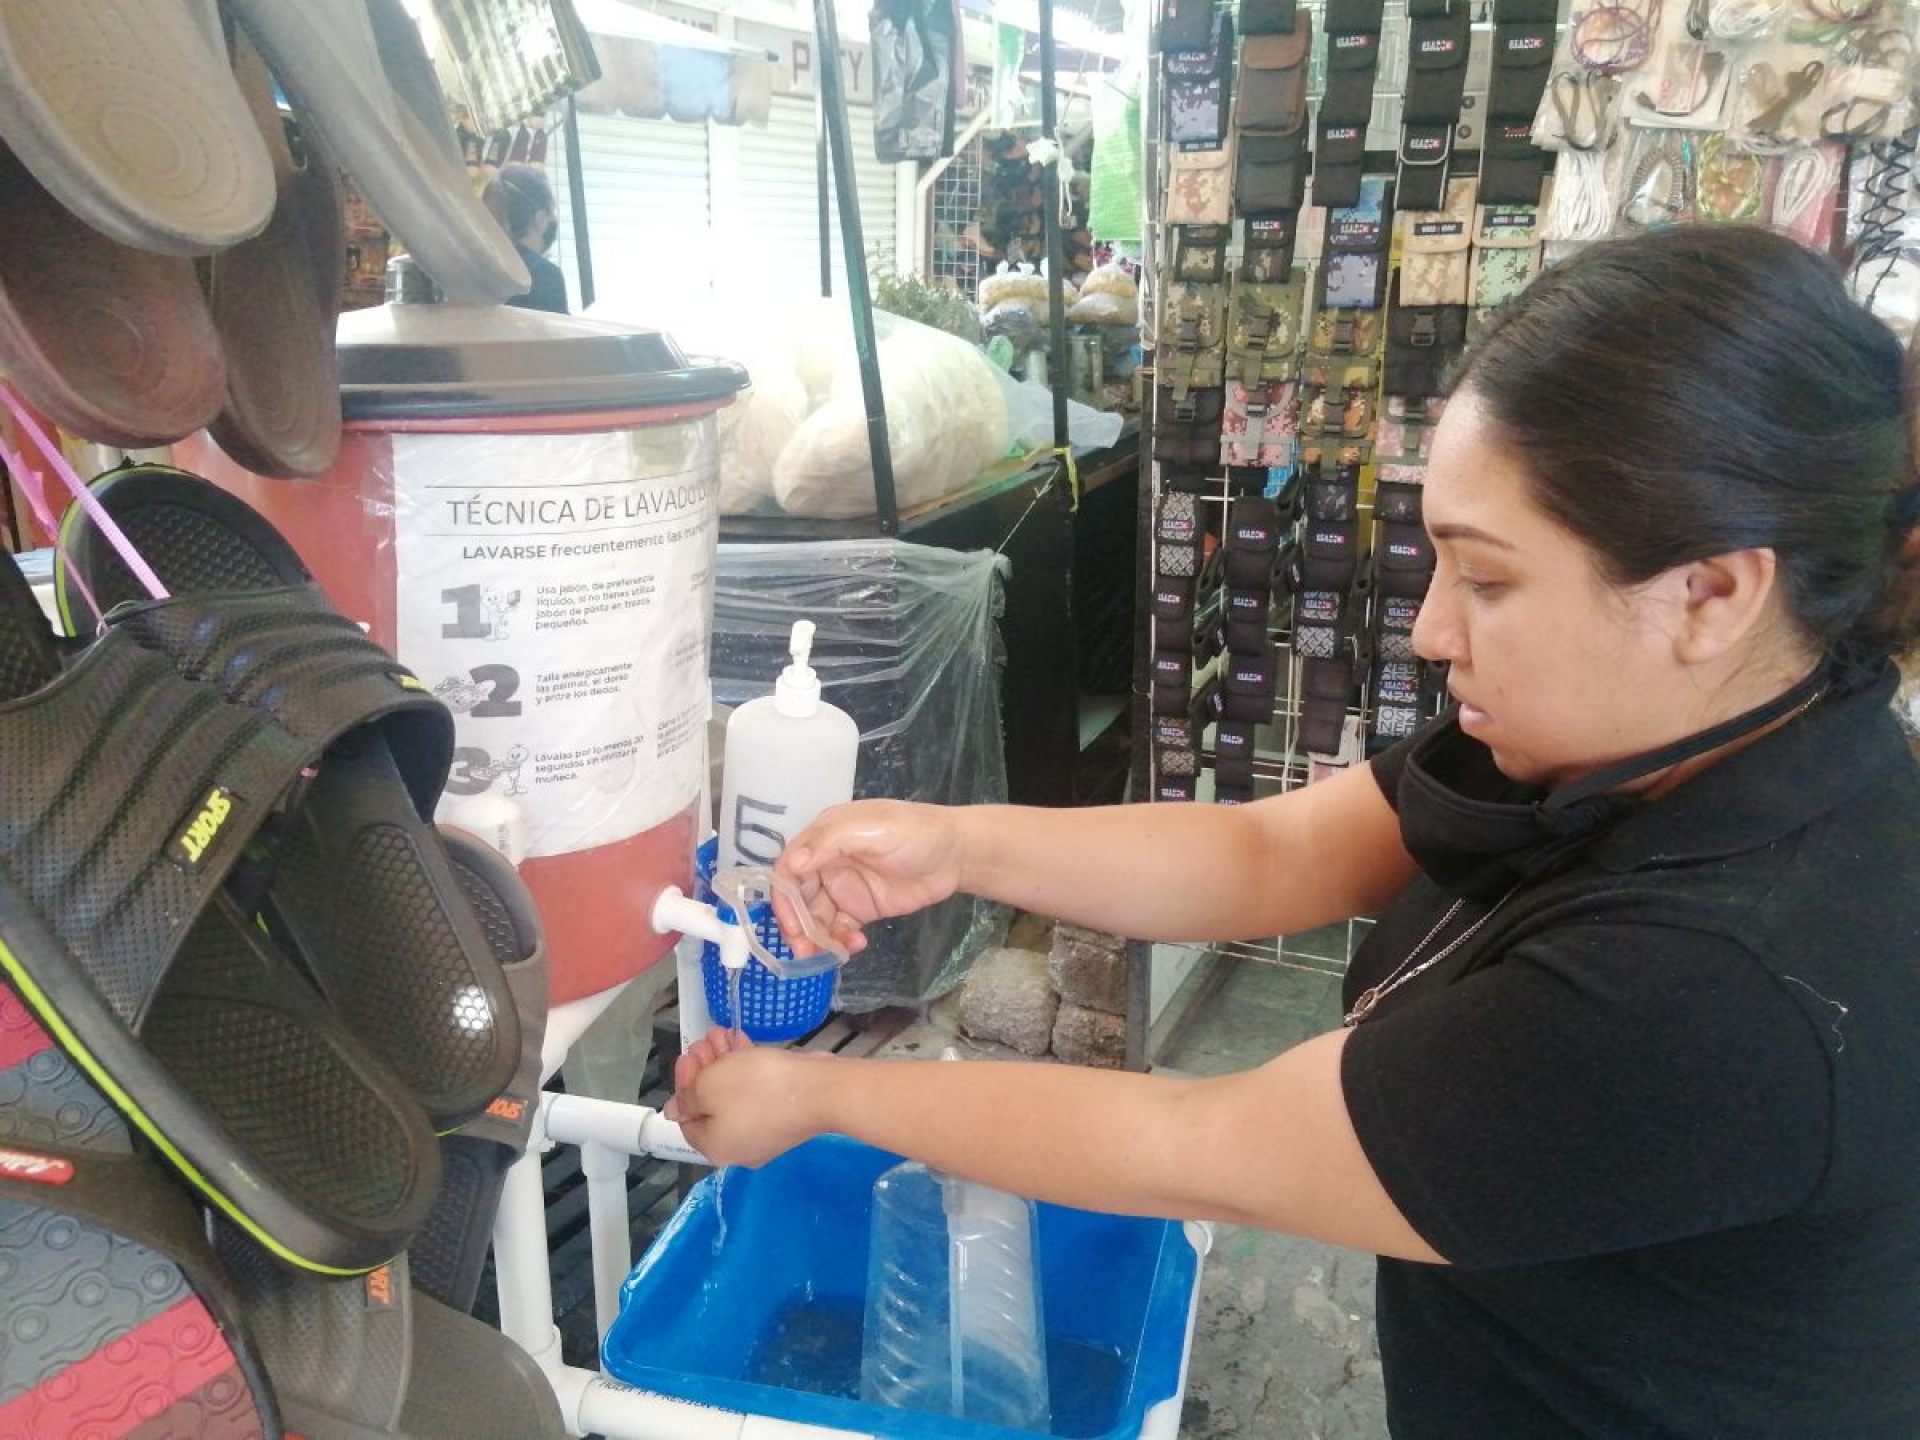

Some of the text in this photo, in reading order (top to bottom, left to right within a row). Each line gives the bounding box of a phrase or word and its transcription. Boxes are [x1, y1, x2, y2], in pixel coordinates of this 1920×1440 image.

[446, 494, 576, 526] TÉCNICA
[585, 496, 615, 521] DE
[625, 484, 697, 518] LAVADO
[463, 545, 546, 560] LAVARSE
[551, 533, 664, 558] frecuentemente
[537, 585, 557, 595] Usa
[589, 592, 601, 601] no
[441, 584, 491, 639] 1
[569, 607, 581, 617] de
[469, 664, 523, 718] 2
[537, 673, 560, 683] Talla
[575, 748, 591, 760] por
[444, 746, 494, 796] 3
[180, 788, 232, 863] SPORT
